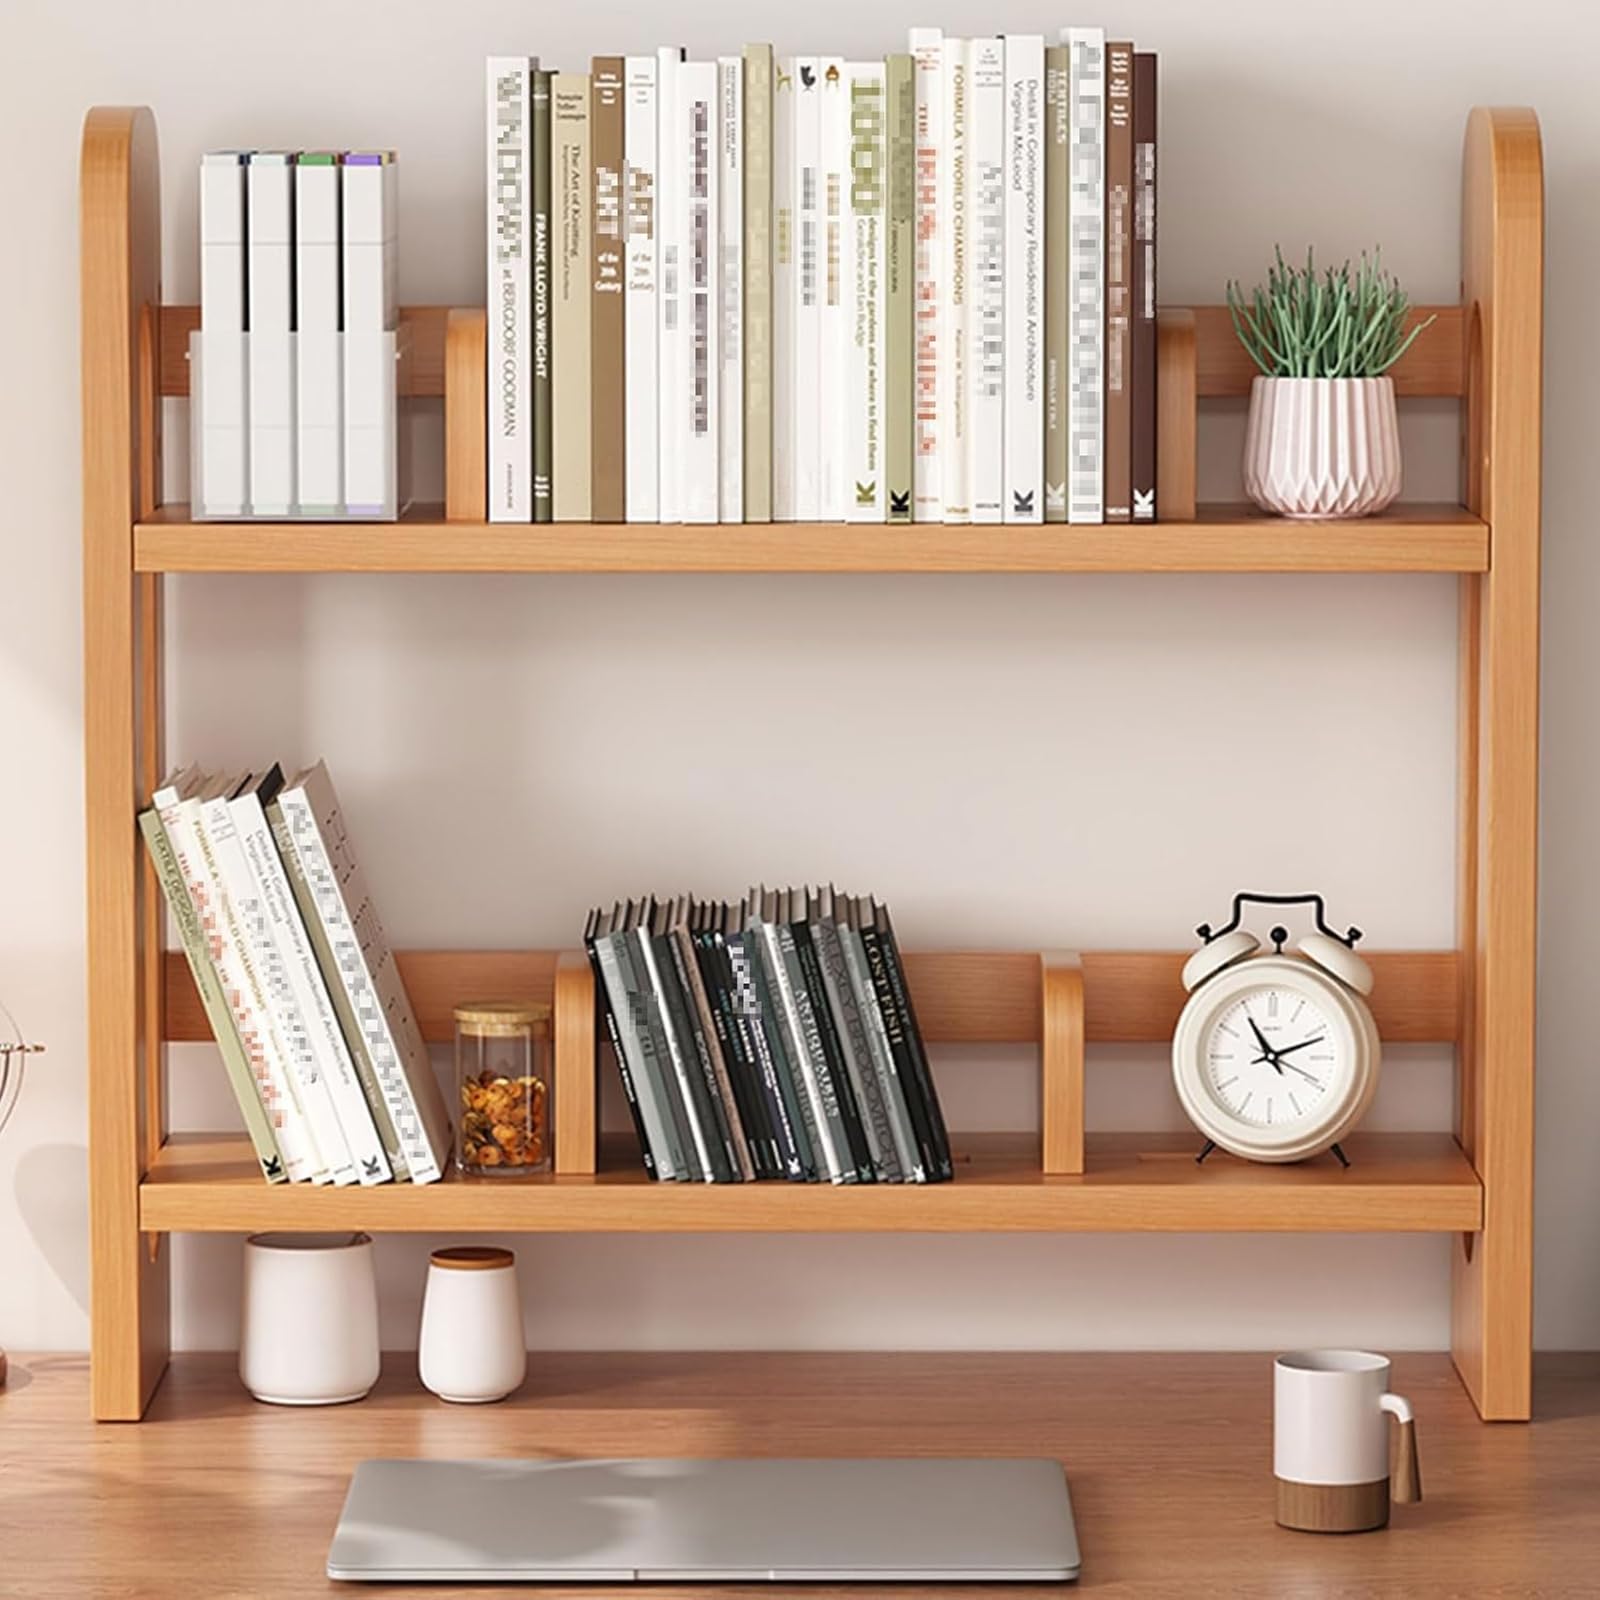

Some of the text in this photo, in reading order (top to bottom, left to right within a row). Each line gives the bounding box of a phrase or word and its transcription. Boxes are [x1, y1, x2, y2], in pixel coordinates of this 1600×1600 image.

[953, 65, 964, 138] FORMULA
[1011, 79, 1023, 191] Virginia McLeod
[569, 144, 581, 257] The Art of Knitting
[953, 154, 964, 212] WORLD
[866, 217, 878, 259] designs
[953, 214, 964, 306] CHAMPIONS
[1024, 79, 1038, 401] Detail in Contemporary Residential Architecture
[535, 213, 547, 379] FRANK LLOYD WRIGHT
[857, 269, 867, 291] and
[868, 261, 878, 277] for
[868, 279, 878, 298] the
[502, 282, 516, 358] BERGDORF
[854, 313, 867, 348] Rudge
[865, 300, 876, 344] gardens
[868, 346, 877, 367] and
[868, 369, 877, 402] where
[502, 359, 516, 437] GOODMAN
[868, 405, 876, 417] to
[868, 418, 877, 441] find
[868, 442, 877, 471] them
[244, 833, 265, 877] Virginia
[190, 817, 220, 880] FORMULA
[233, 937, 267, 1011] CHAMPIONS
[254, 827, 274, 864] Detail
[271, 874, 306, 956] Contemporary
[321, 1018, 352, 1085] Architecture
[863, 931, 889, 991] LOST
[794, 986, 840, 1118] ANTIQUAIRES
